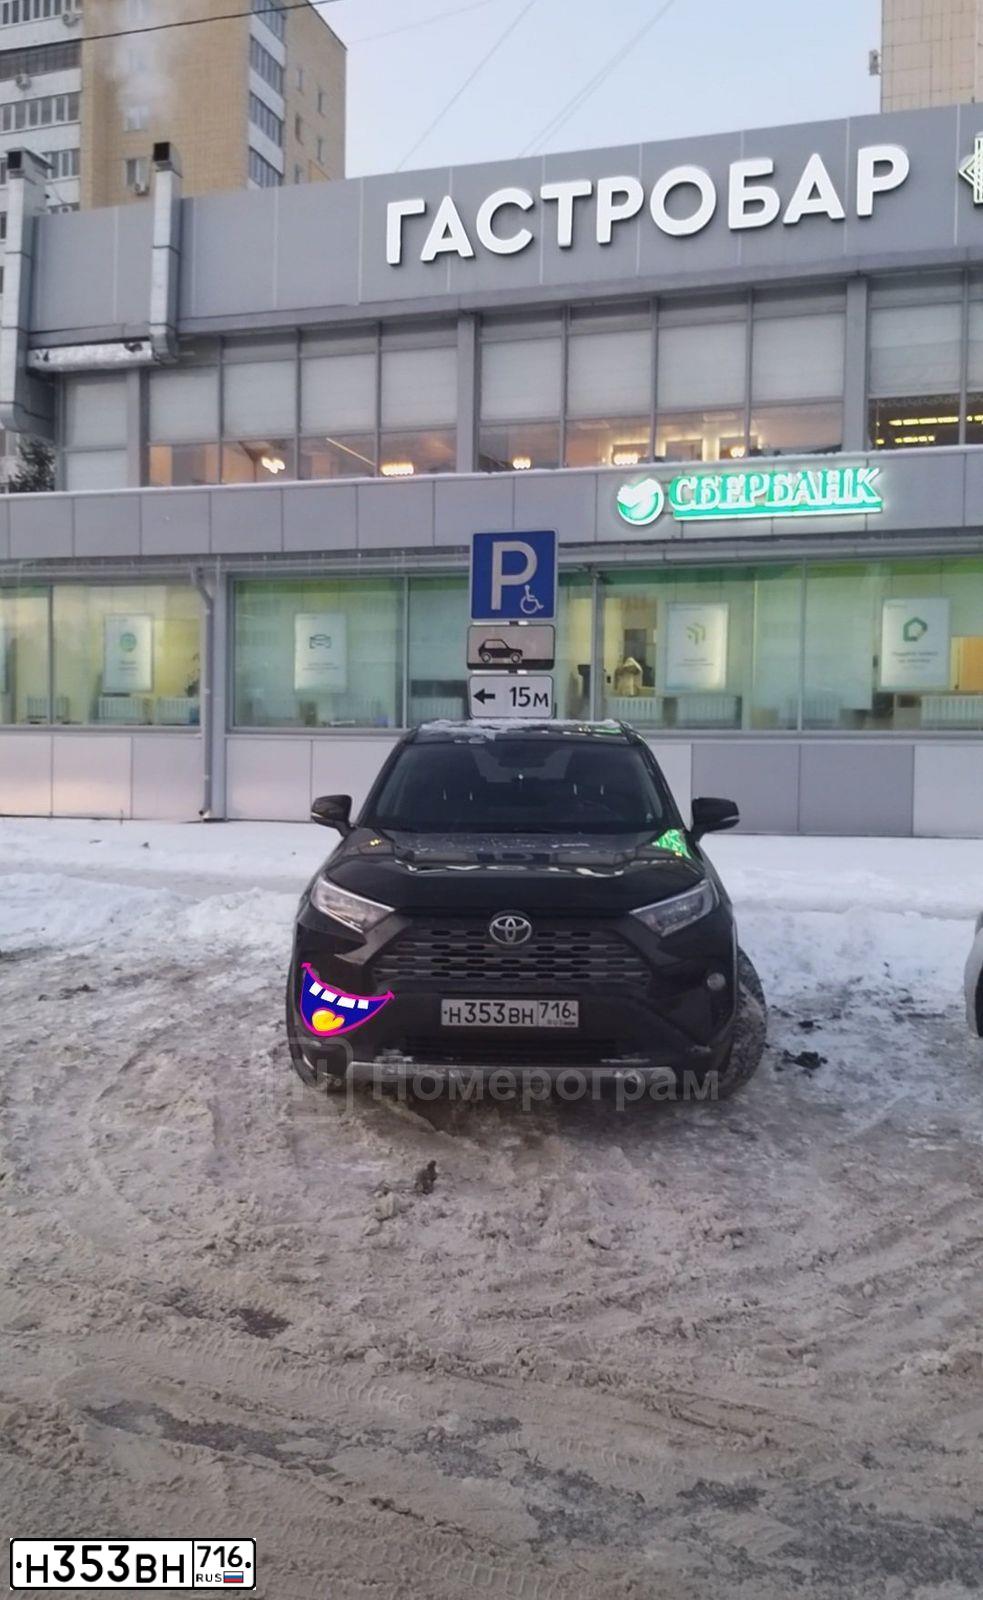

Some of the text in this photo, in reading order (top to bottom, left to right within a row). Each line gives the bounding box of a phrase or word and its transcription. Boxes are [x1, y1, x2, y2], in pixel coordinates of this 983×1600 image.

[386, 145, 911, 265] ГАСТРОБАР
[669, 468, 882, 511] СБЕРБАНК
[490, 540, 538, 611] P
[539, 1002, 571, 1019] 716
